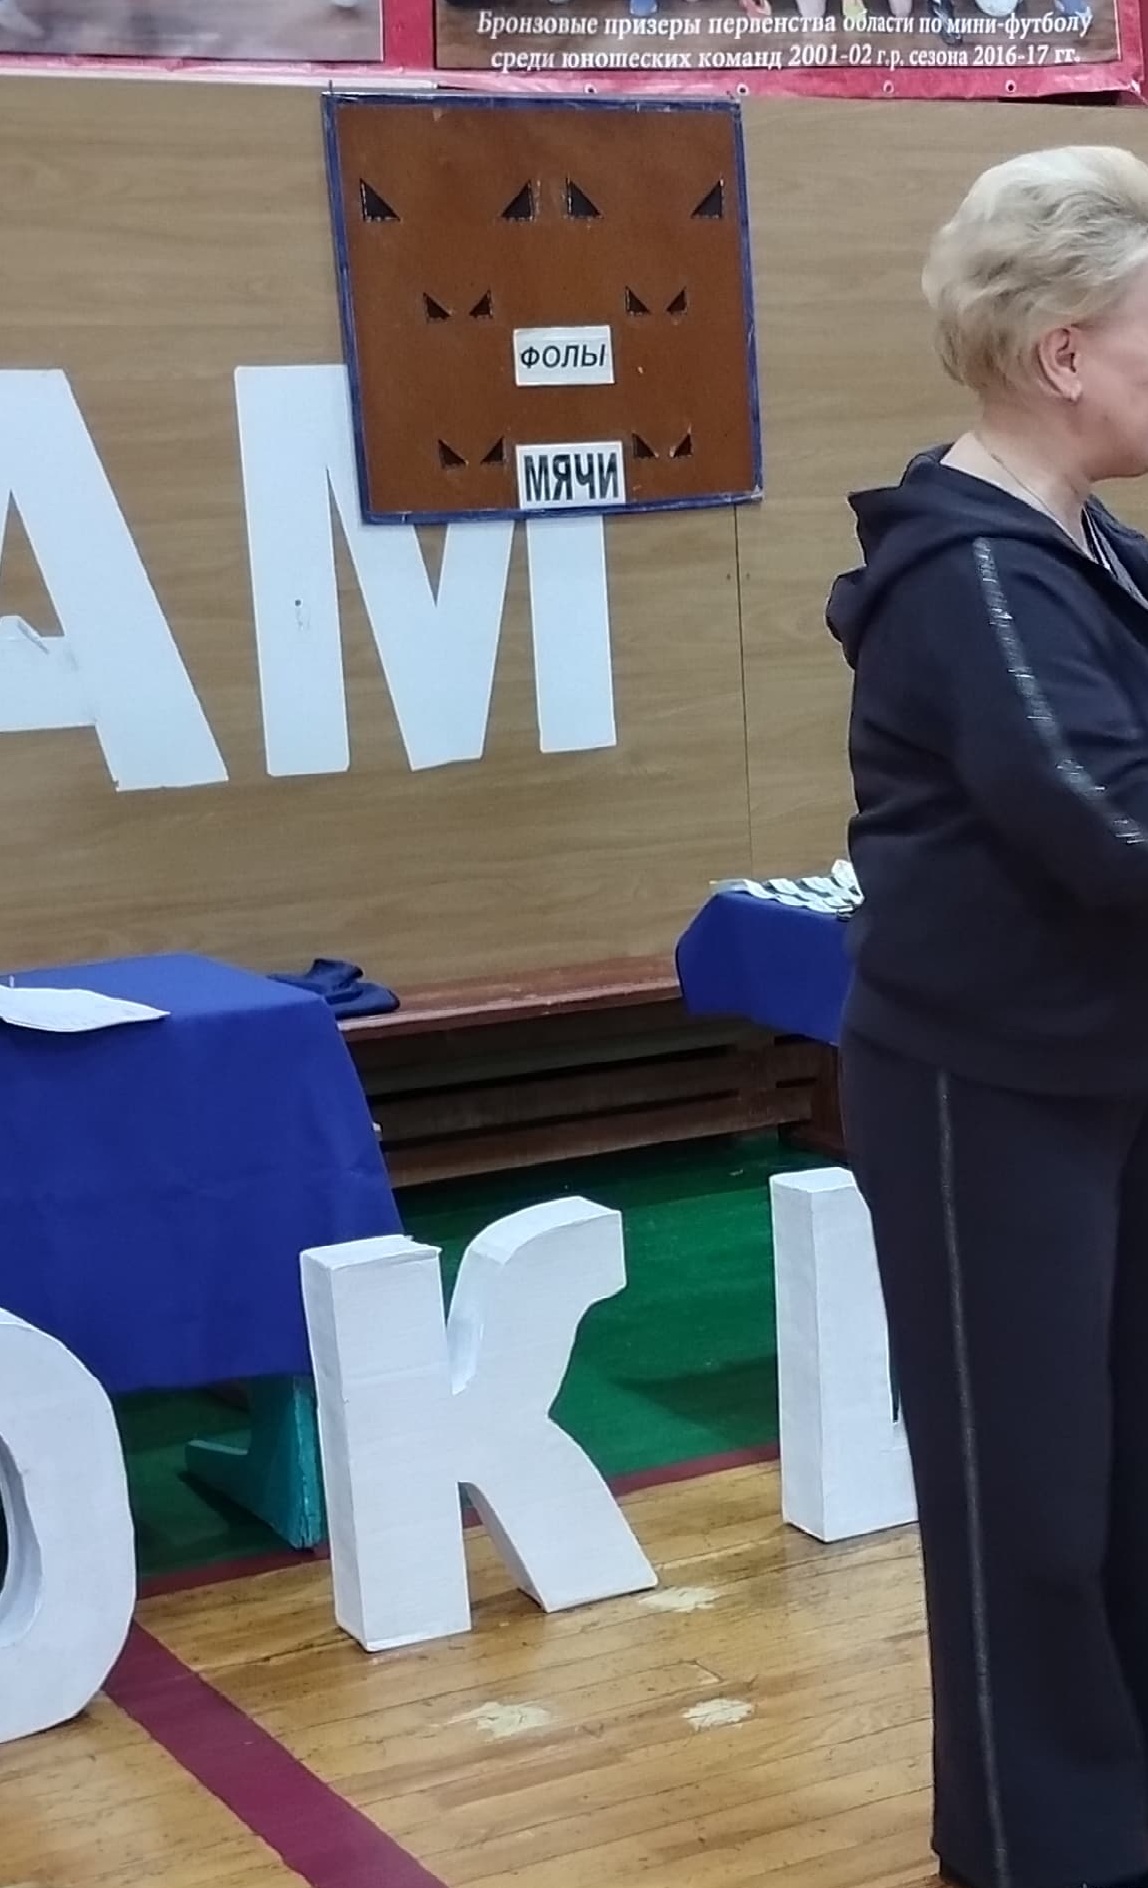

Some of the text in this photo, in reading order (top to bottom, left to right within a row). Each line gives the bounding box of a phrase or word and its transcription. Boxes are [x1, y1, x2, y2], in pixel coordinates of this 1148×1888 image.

[477, 10, 1093, 39] Бронзовые призеры первенства области по мини-футболу
[491, 50, 555, 73] среди
[562, 50, 691, 69] юношеских
[698, 49, 782, 70] команд
[788, 44, 872, 65] 2001-02
[909, 49, 970, 66] сезона
[973, 44, 1049, 65] 2016-17
[520, 344, 606, 368] ФОЛЫ
[523, 452, 619, 501] МЯЧИ
